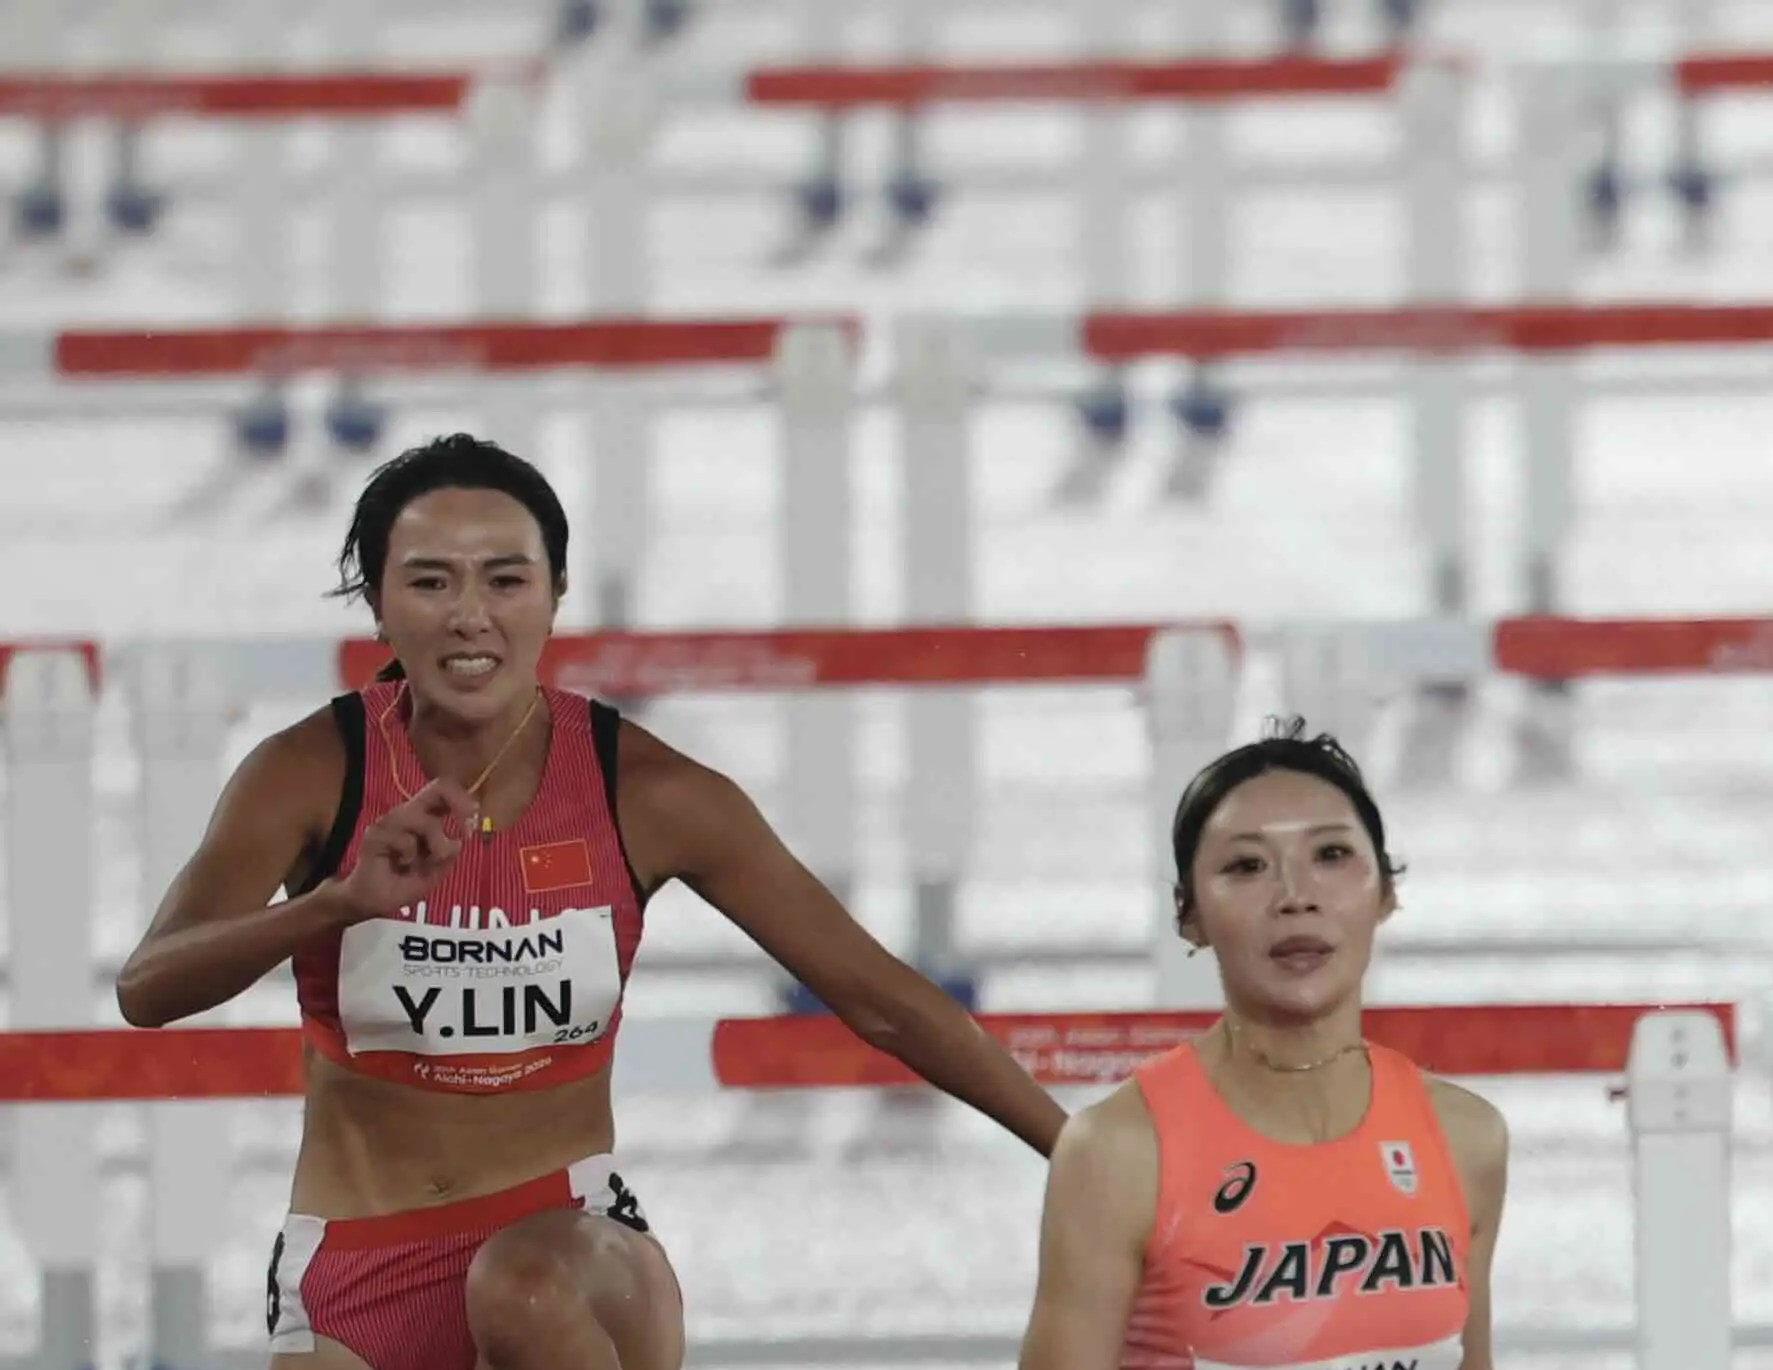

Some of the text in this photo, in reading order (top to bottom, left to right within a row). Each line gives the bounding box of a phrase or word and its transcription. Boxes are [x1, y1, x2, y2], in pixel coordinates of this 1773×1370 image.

[399, 929, 563, 963] BORNAN
[392, 979, 572, 1038] Y.LIN
[553, 1021, 599, 1043] 264
[1203, 1228, 1458, 1308] JAPAN
